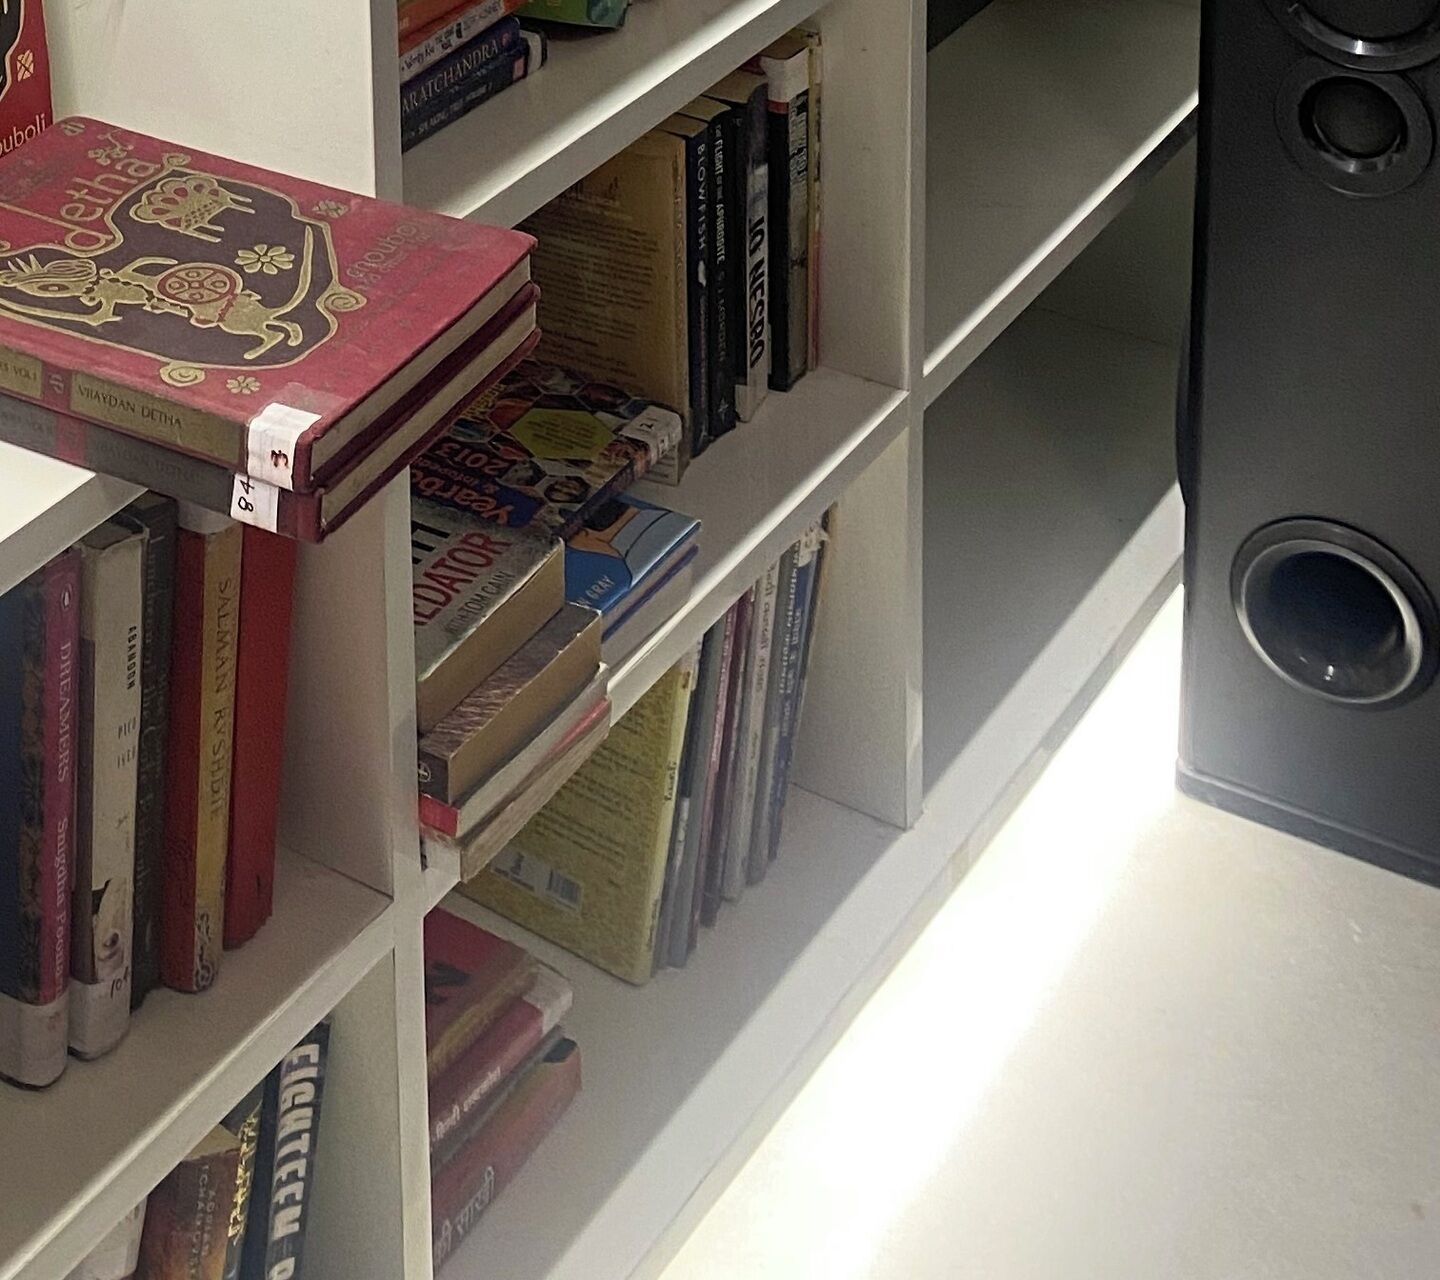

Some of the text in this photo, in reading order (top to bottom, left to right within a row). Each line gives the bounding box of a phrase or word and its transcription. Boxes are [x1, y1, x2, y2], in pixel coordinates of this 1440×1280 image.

[697, 143, 706, 251] BLOWFISH
[77, 383, 183, 429] VIJAYDAN DETHA
[215, 577, 235, 694] SALMAN
[586, 575, 615, 600] GRAY
[127, 625, 137, 690] ABANDON
[54, 641, 71, 907] DREAMERS Snigdha
[271, 1043, 320, 1241] EIGHTEEN
